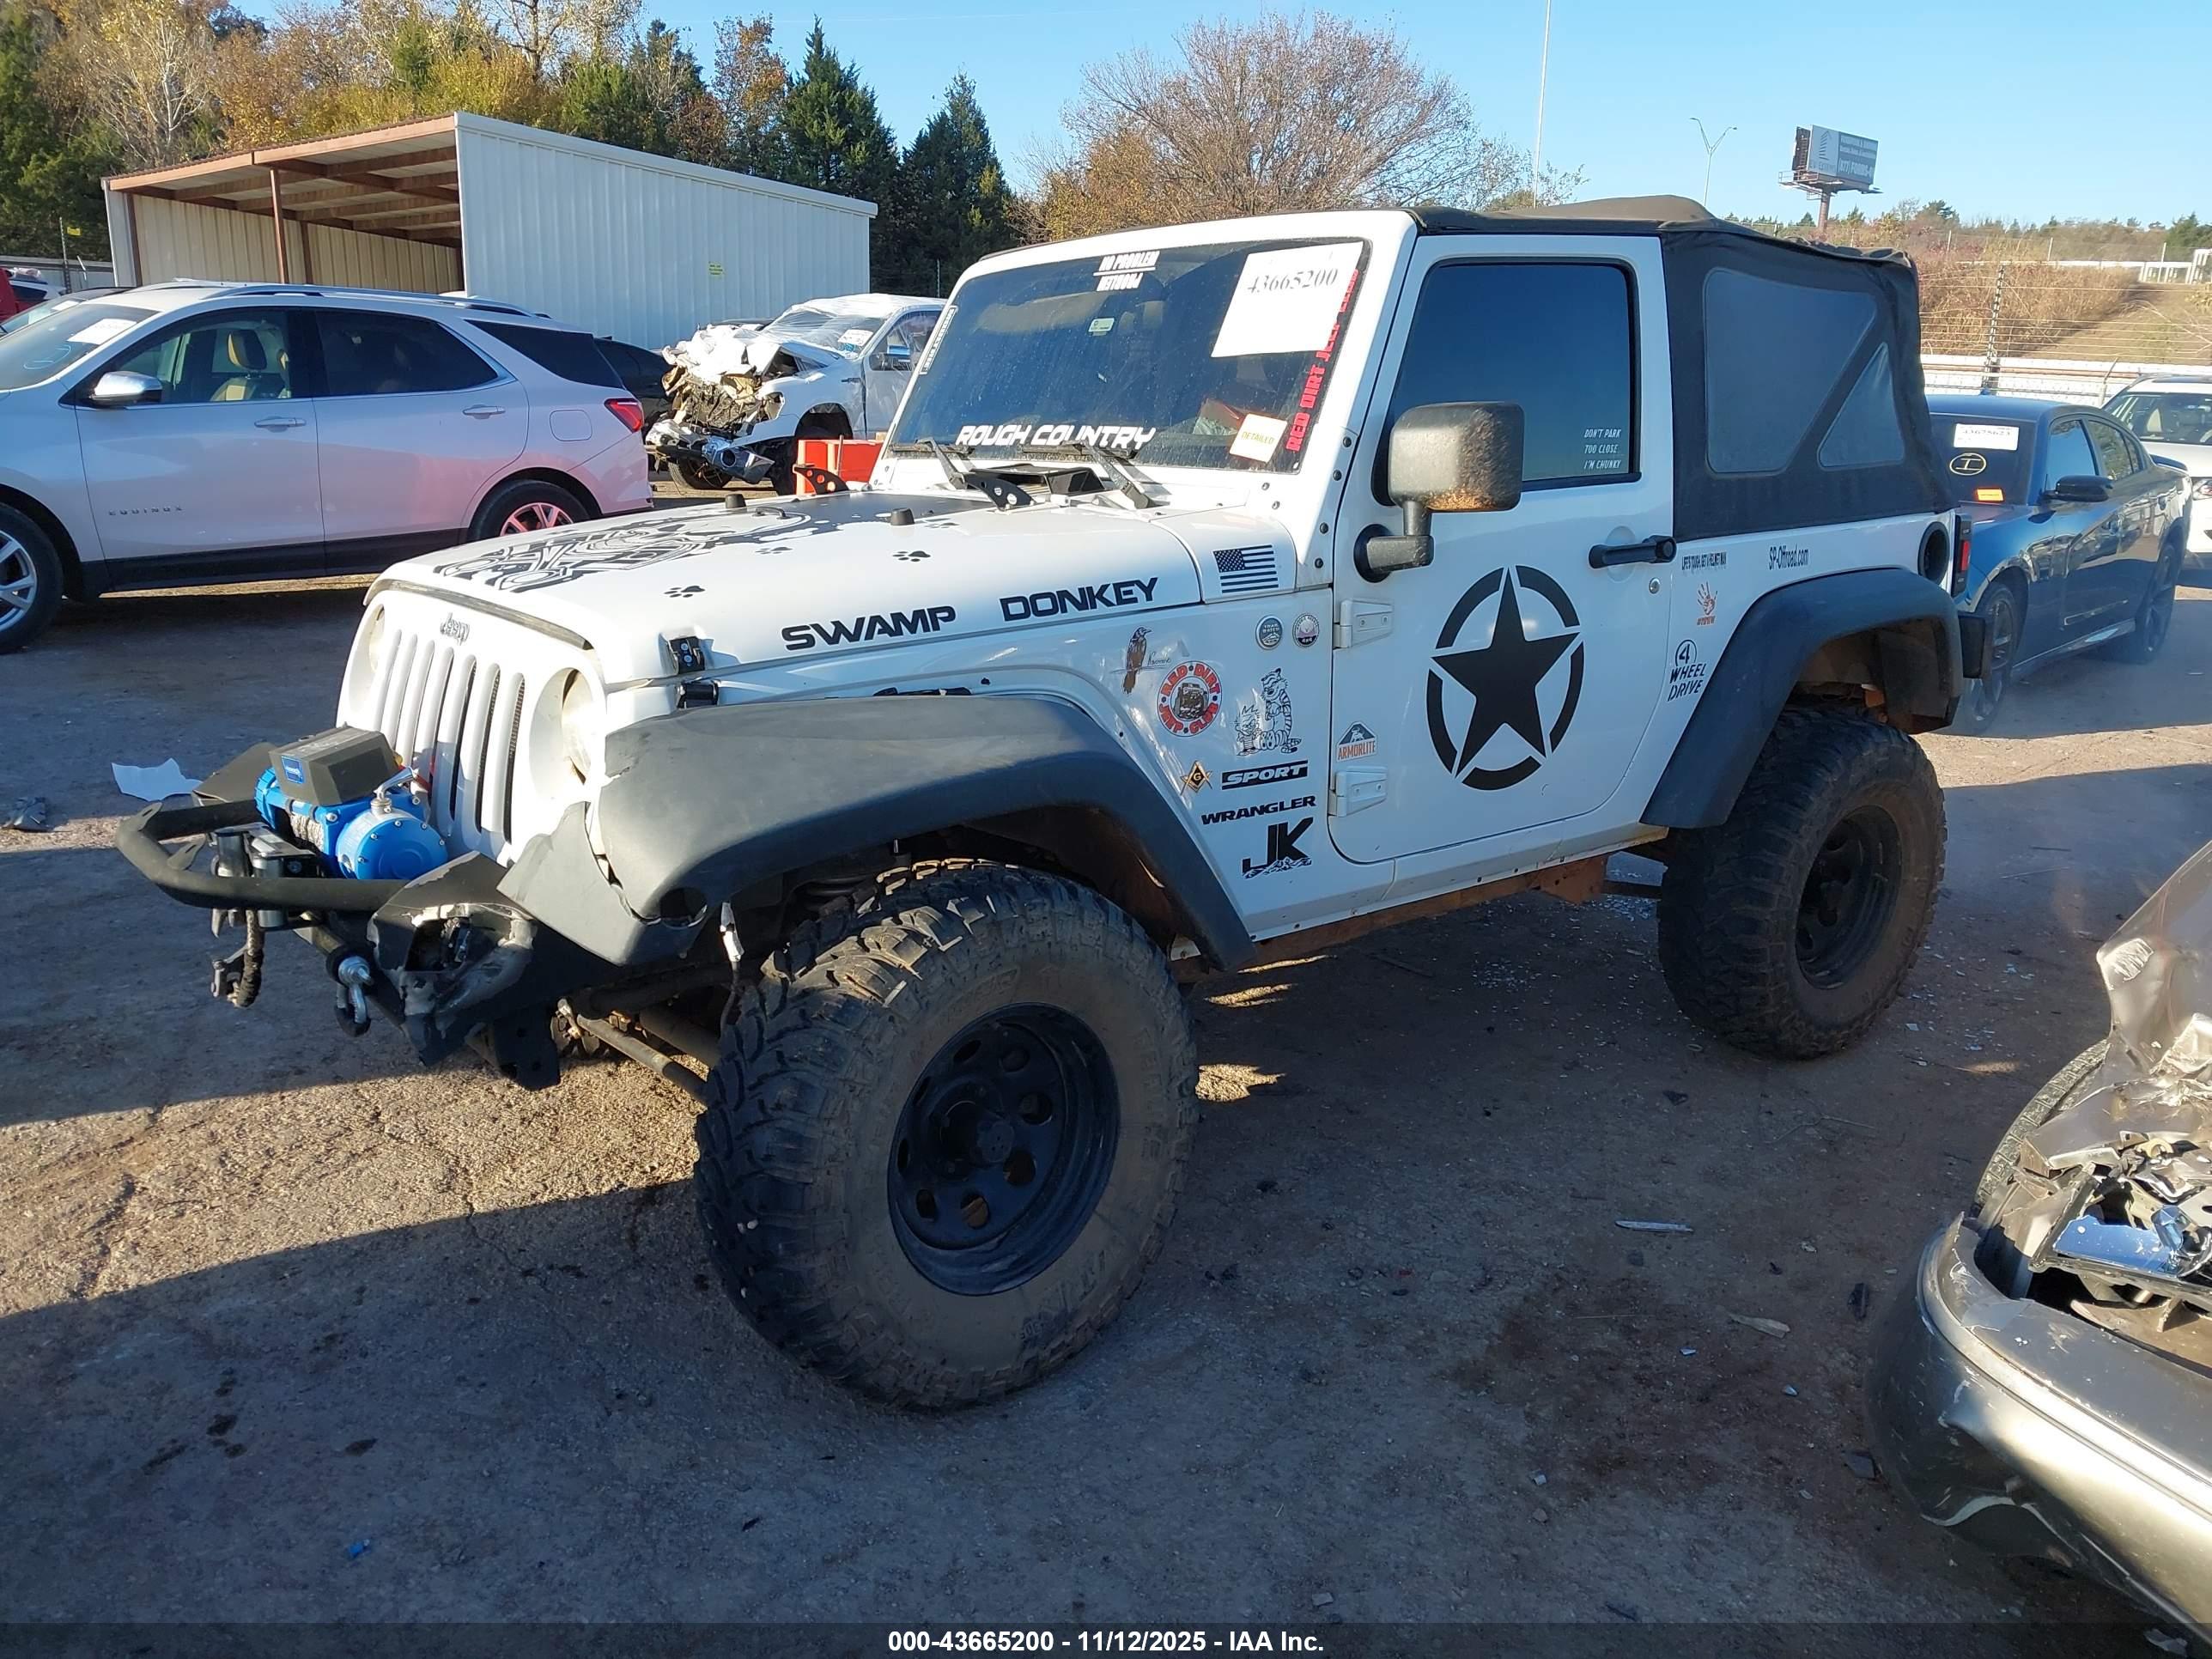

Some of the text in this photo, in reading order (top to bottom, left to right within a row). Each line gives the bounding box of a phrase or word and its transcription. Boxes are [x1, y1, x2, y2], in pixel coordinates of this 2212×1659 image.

[1248, 268, 1338, 293] 43665200
[1285, 412, 1310, 451] RED
[1300, 364, 1326, 409] DIRT
[956, 424, 1156, 450] ROUGH COUNTRY
[1584, 428, 1621, 438] DON'T PARK
[1584, 444, 1597, 453] TOO
[1596, 459, 1621, 469] CHUNKY
[1769, 545, 1809, 570] SP-Offroad.com
[781, 577, 1158, 651] SWAMP DONKEY
[440, 612, 470, 646] Jeep
[1679, 644, 1690, 664] 4
[1161, 664, 1220, 696] RED DIRT
[1670, 663, 1706, 684] WHEEL
[1668, 679, 1704, 702] DRIVE
[1159, 702, 1218, 734] JEEP CLUB
[1338, 741, 1375, 761] ARMORLITE
[1227, 763, 1304, 785] SPORT
[1201, 795, 1316, 825] WRANGLER
[1242, 817, 1314, 874] JK
